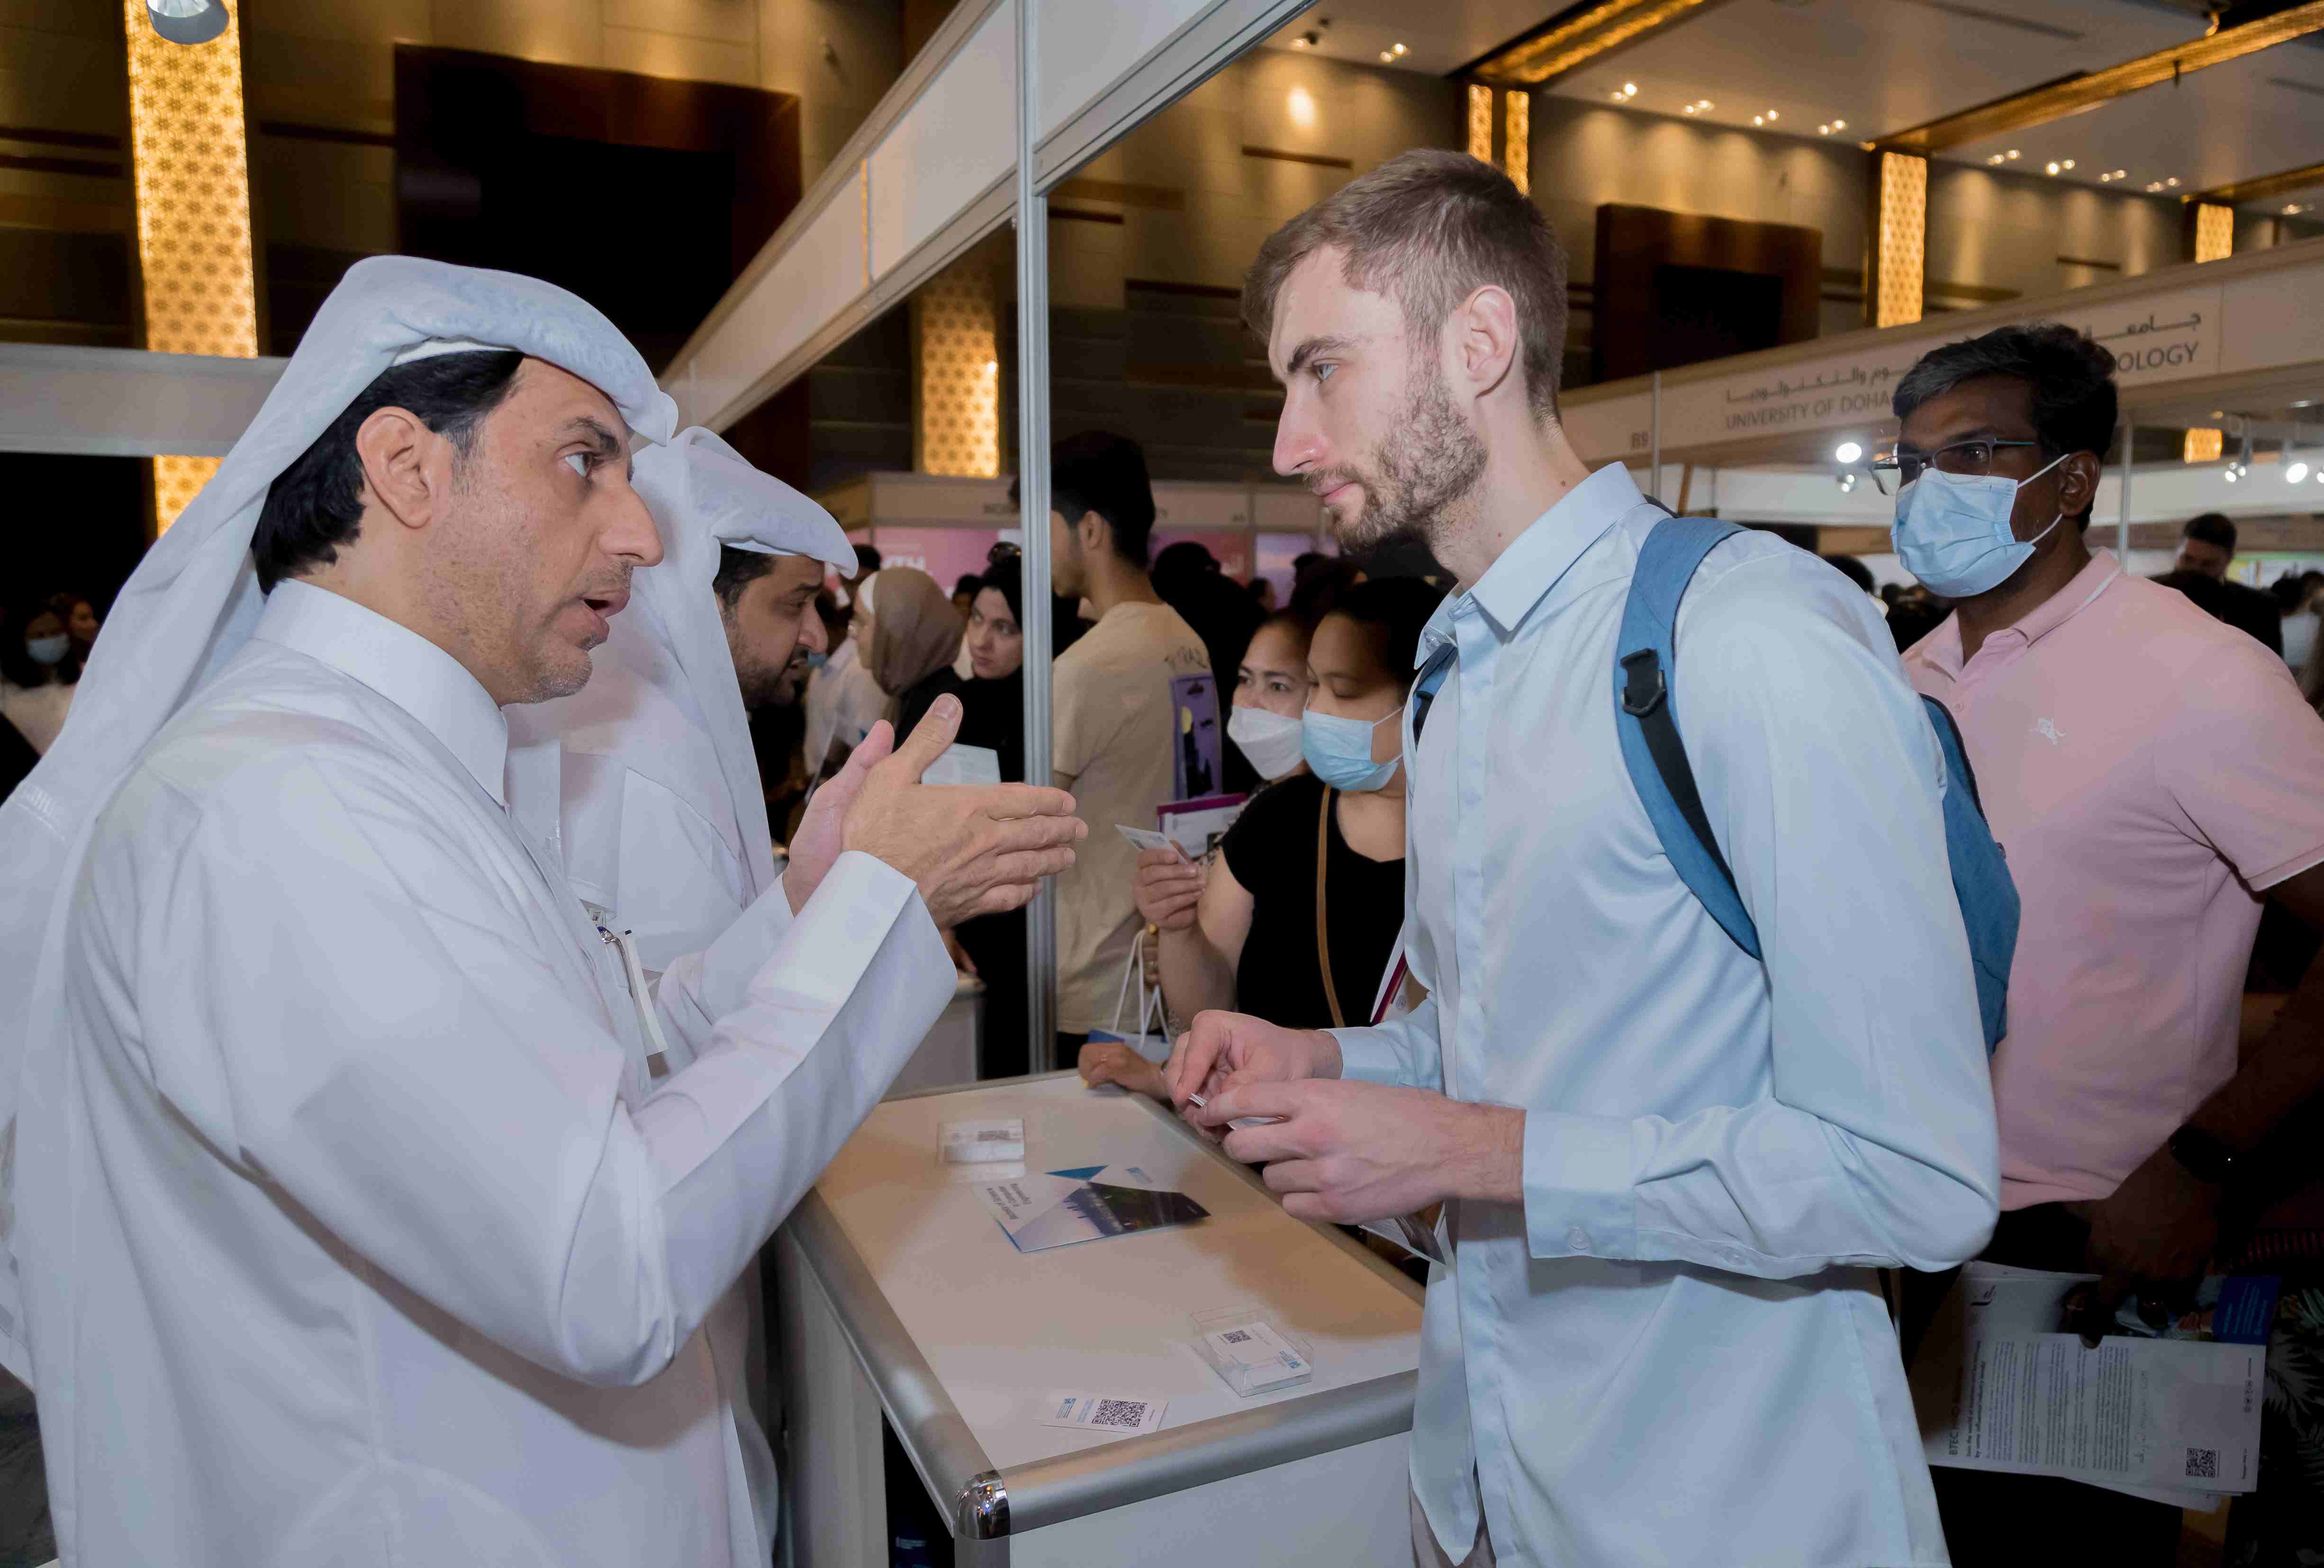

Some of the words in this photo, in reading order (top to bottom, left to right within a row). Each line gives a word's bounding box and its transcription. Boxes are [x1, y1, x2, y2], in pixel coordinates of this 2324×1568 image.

[1727, 403, 1808, 429] UNIVERSITY
[1814, 397, 1836, 416] OF
[1841, 390, 1890, 412] DOHA
[2116, 341, 2199, 372] OLOGY
